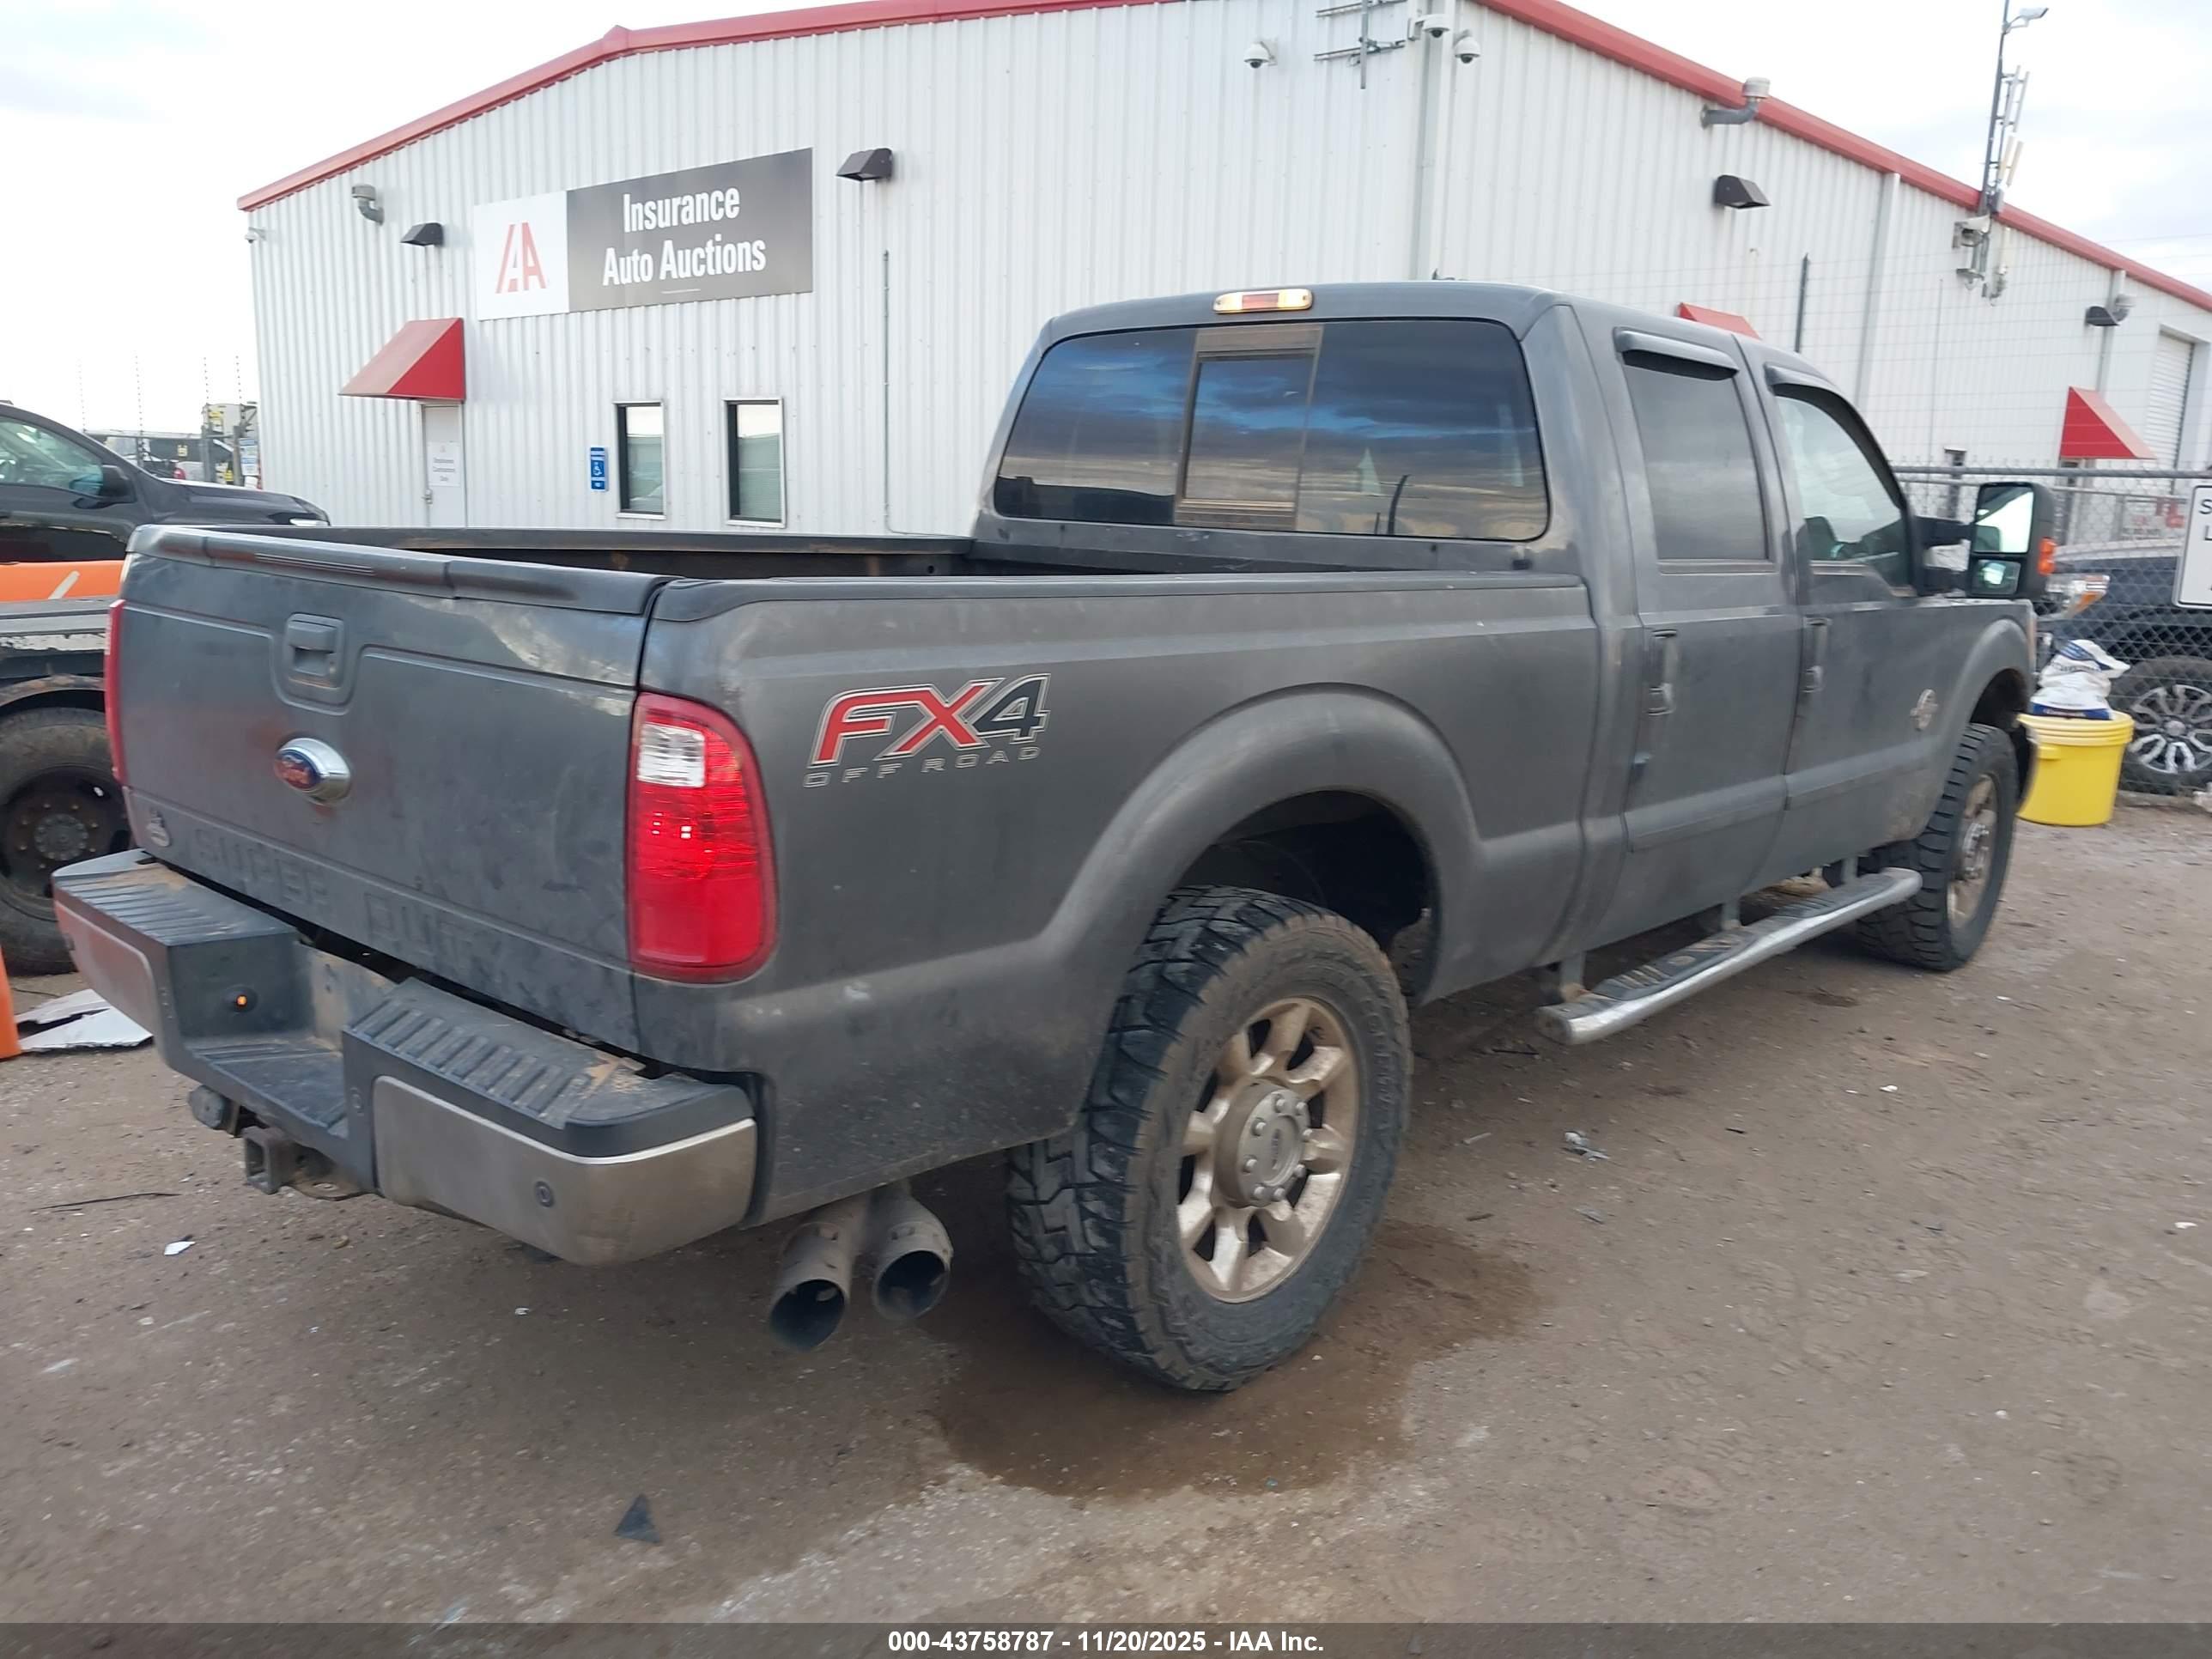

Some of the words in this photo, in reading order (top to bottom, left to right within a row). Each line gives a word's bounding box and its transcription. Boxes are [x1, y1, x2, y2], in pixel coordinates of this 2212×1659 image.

[623, 188, 740, 233] Insurance
[602, 247, 653, 286] Auto
[659, 234, 767, 280] Auctions
[807, 673, 1051, 769] FX4
[803, 763, 902, 787] OFF
[921, 746, 1041, 773] ROAD
